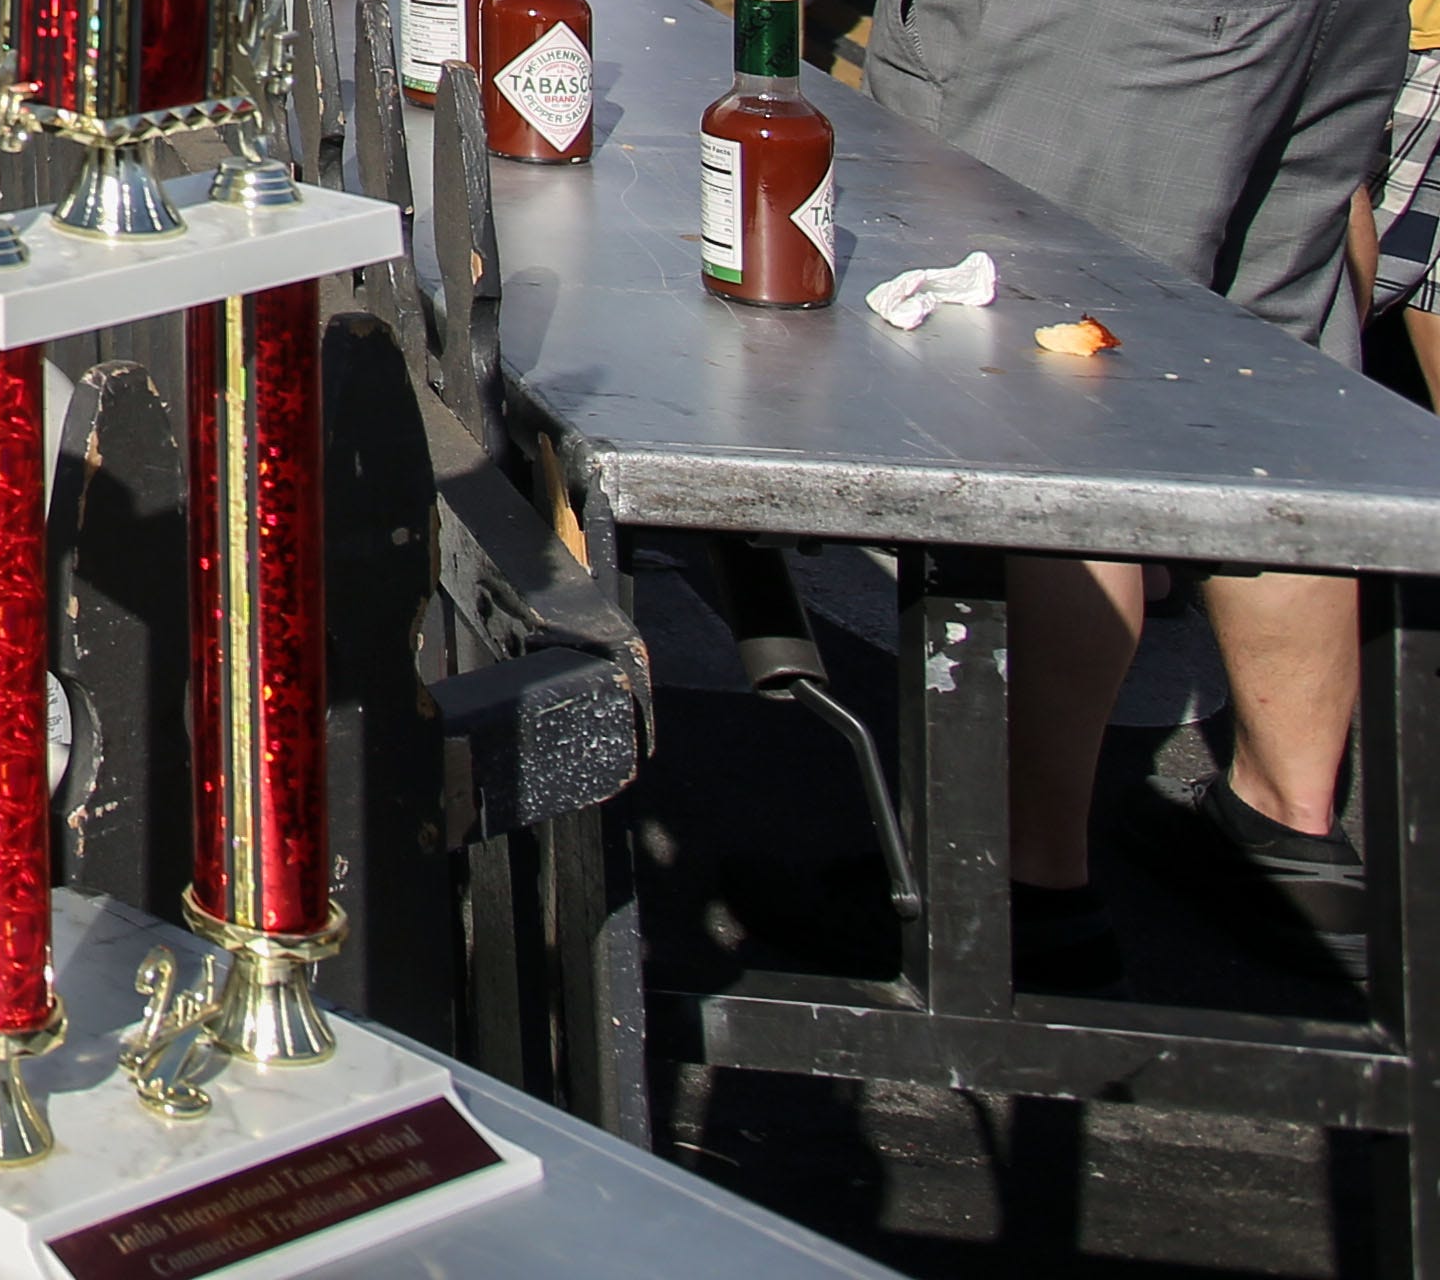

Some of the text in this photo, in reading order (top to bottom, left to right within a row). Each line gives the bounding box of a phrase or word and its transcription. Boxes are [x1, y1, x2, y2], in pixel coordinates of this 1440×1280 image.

[523, 94, 564, 124] PEPPER
[543, 95, 577, 104] BRAND
[108, 1124, 426, 1257] Indio International Tamale Festival
[365, 1158, 433, 1195] Tamale
